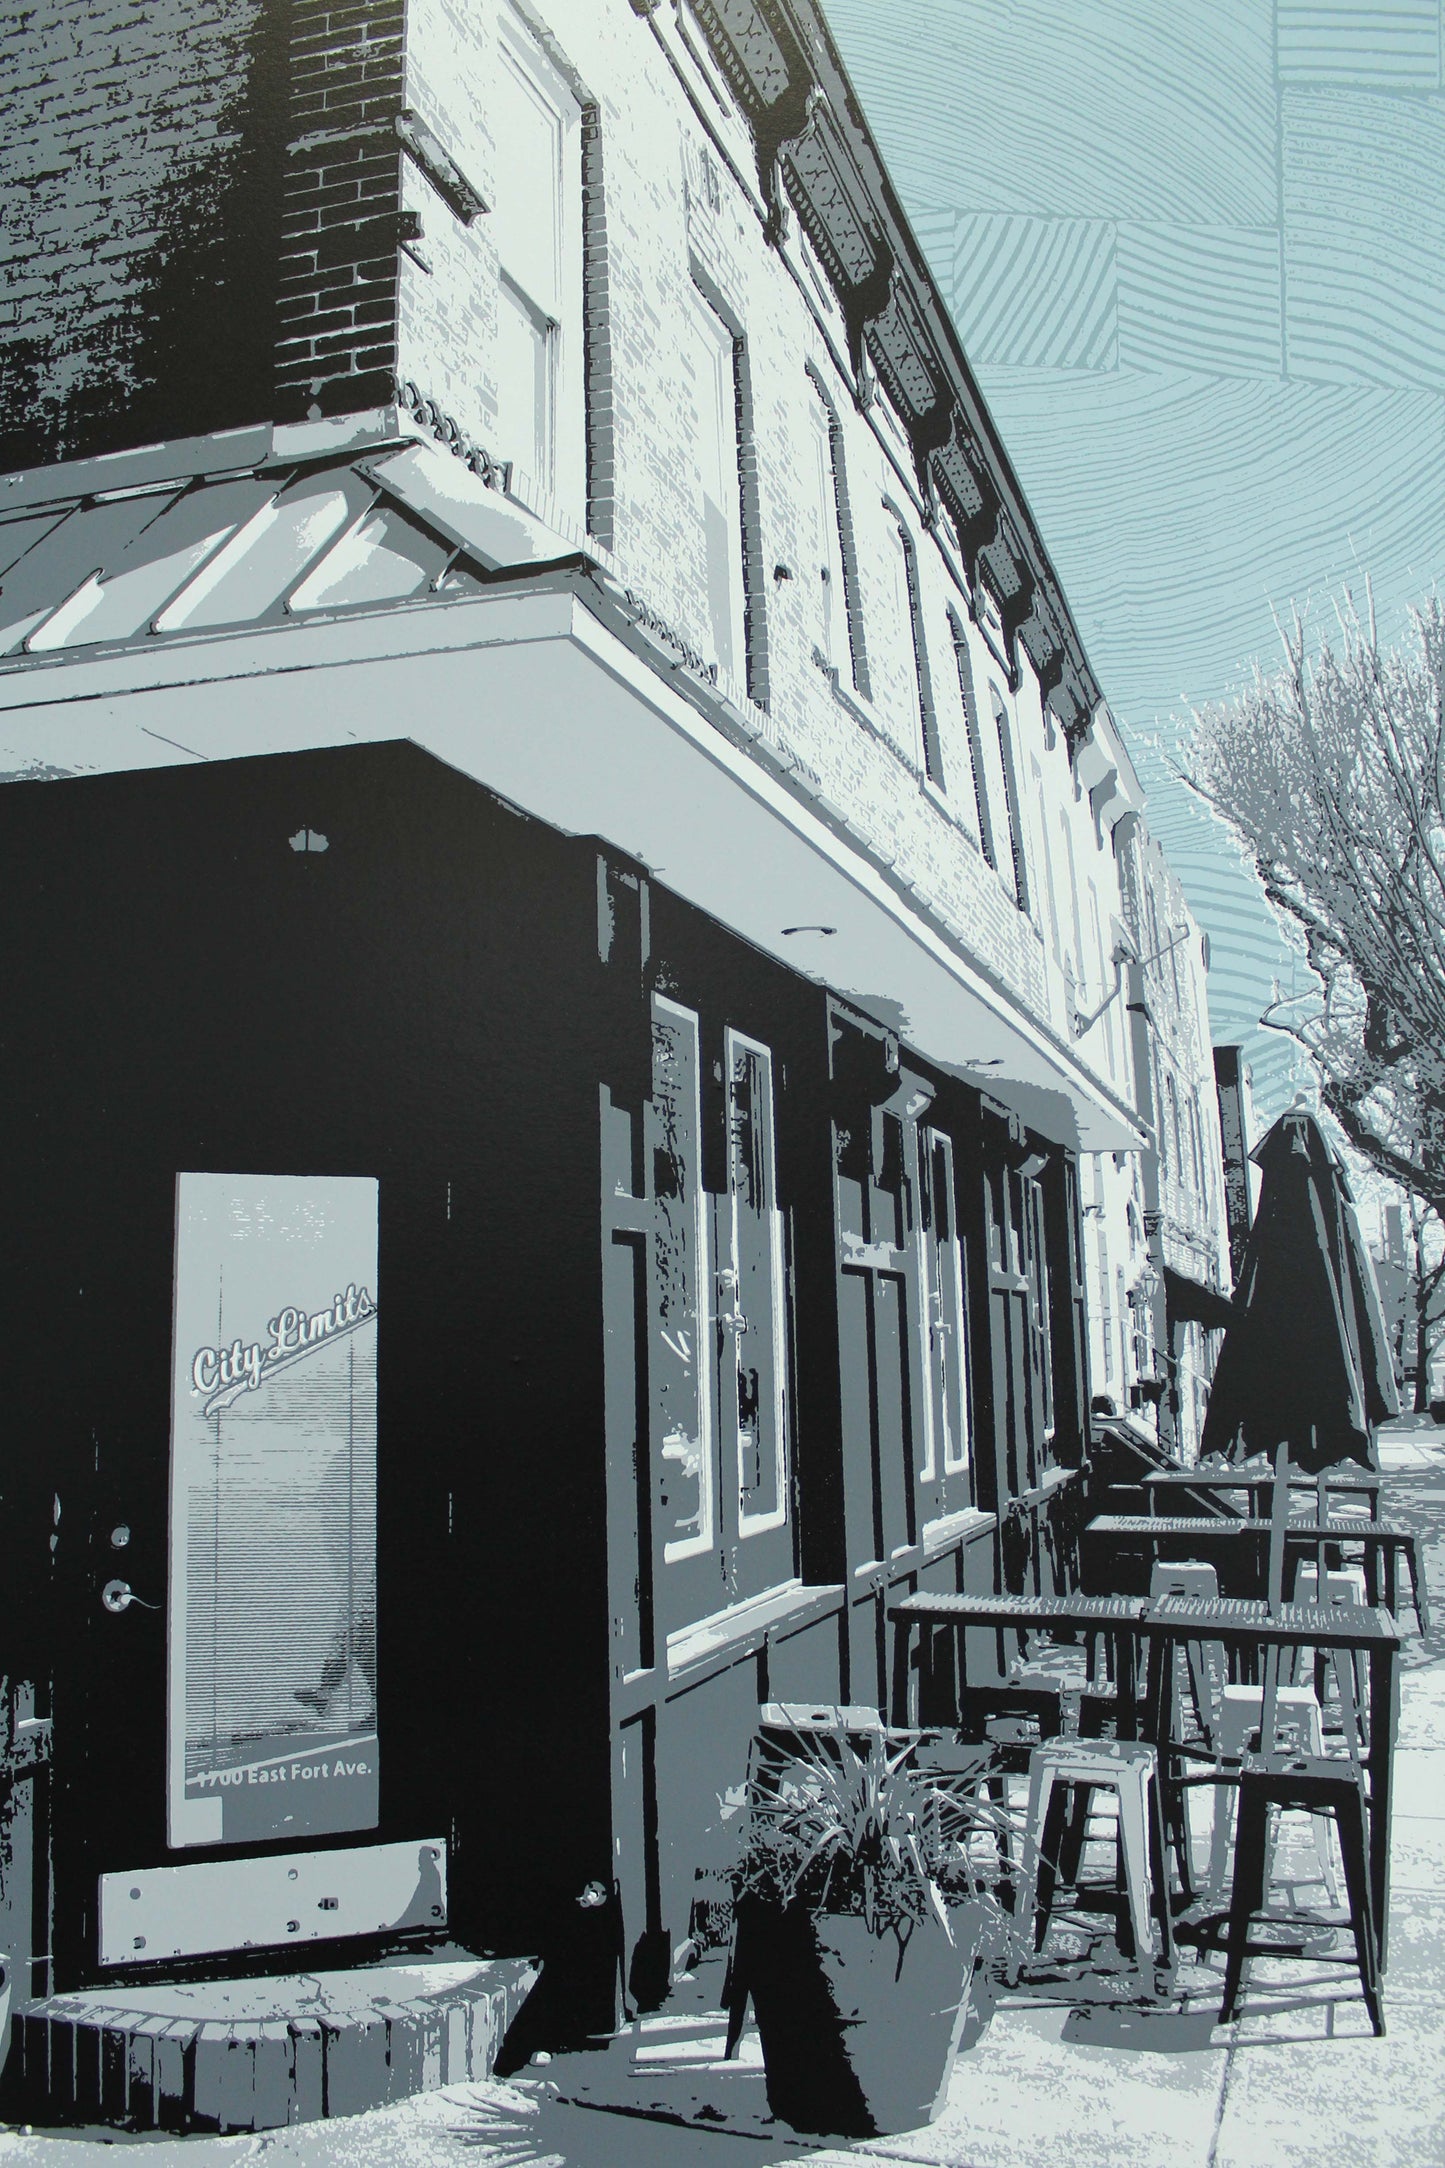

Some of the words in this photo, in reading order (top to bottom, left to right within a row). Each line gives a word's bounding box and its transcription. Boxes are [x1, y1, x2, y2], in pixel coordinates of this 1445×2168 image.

[193, 1339, 265, 1393] City
[268, 1283, 375, 1359] Limits
[197, 1770, 243, 1788] 1700
[248, 1766, 286, 1784] East
[292, 1764, 328, 1780] Fort
[333, 1760, 372, 1776] Ave.
